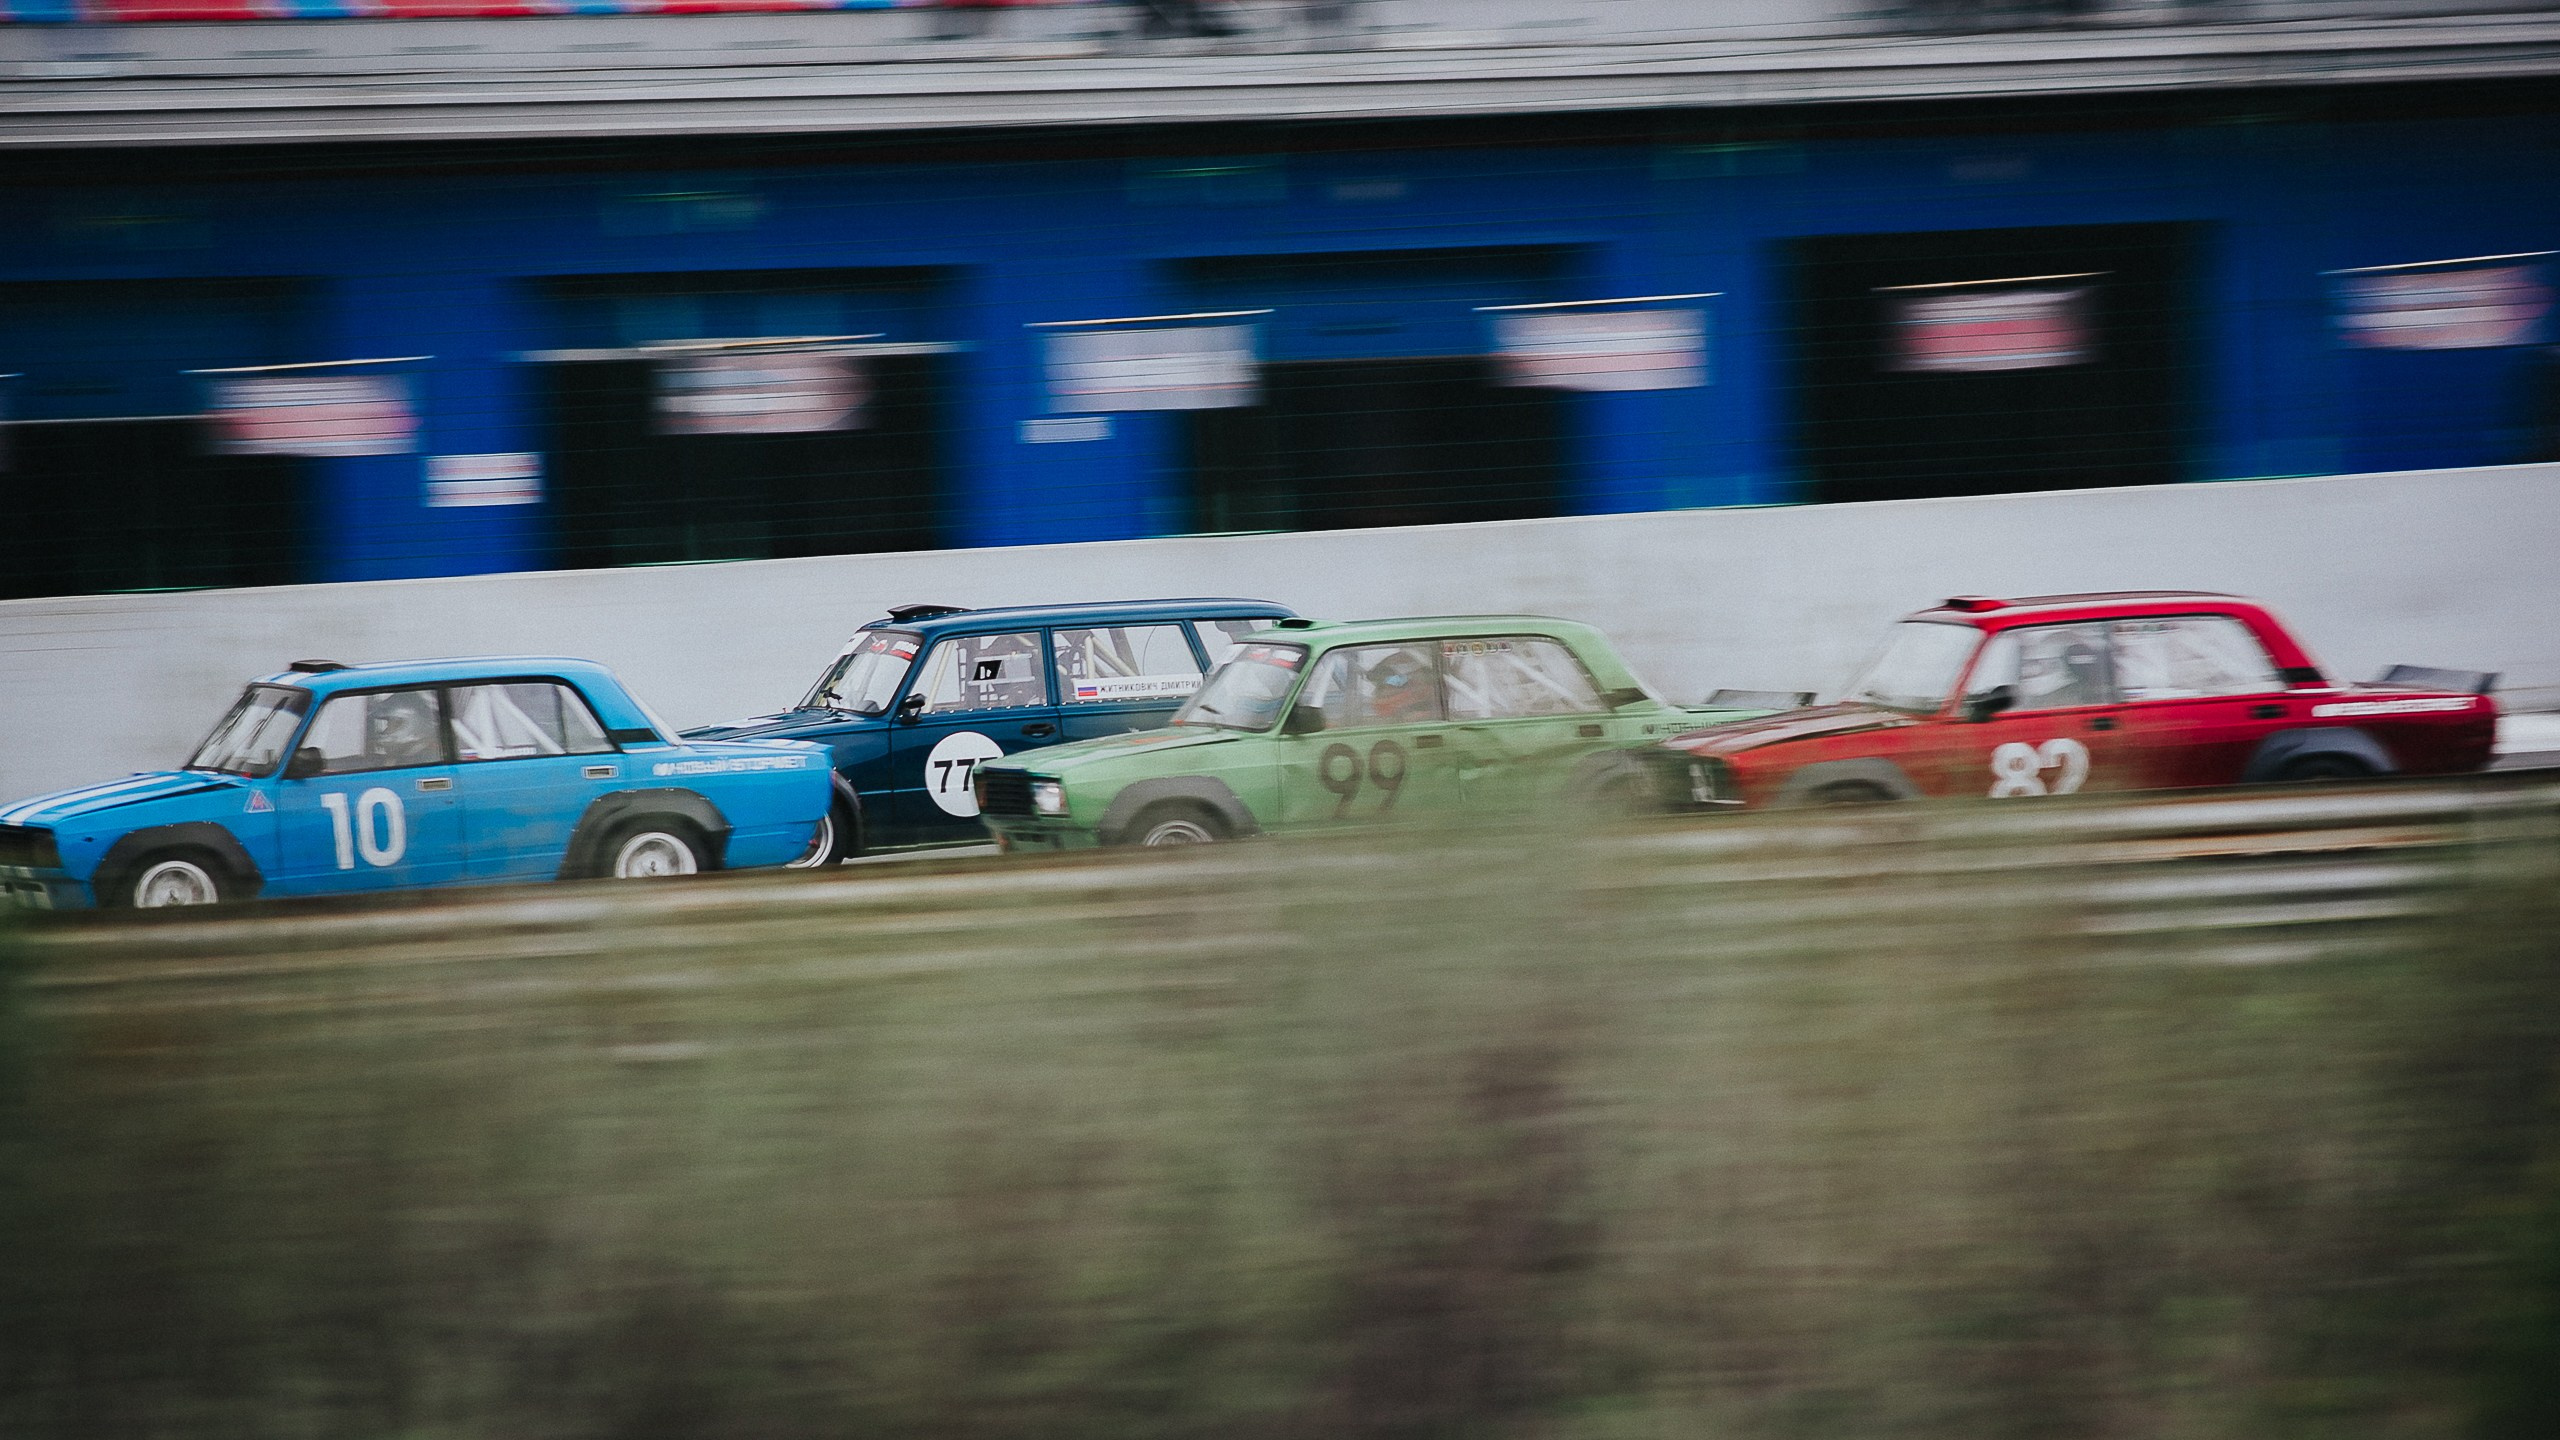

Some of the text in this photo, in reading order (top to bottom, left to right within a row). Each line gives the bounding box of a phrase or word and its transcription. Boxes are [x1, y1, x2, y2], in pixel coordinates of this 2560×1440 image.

[934, 757, 998, 793] 77
[1319, 740, 1406, 820] 99
[320, 787, 407, 870] 10
